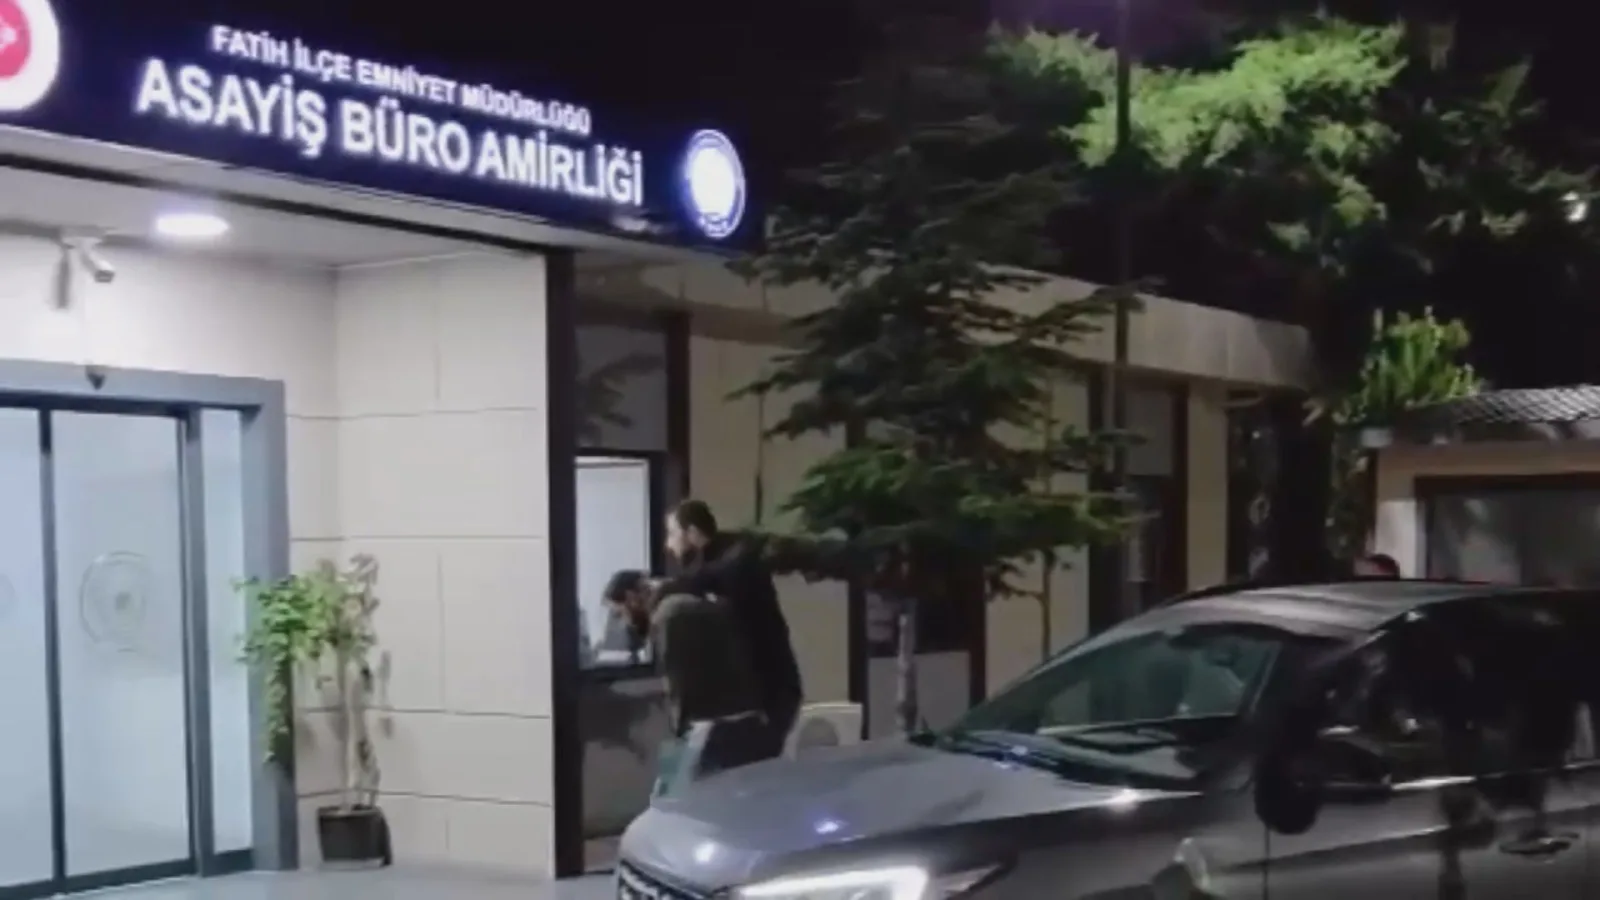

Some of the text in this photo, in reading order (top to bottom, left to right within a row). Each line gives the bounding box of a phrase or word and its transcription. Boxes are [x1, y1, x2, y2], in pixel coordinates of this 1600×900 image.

[134, 57, 643, 206] ASAYİŞ BÜRO AMİRLİĞİ
[210, 25, 592, 136] FATİH İLÇE EMNİYET MÜDÜRLÜĞÜ
